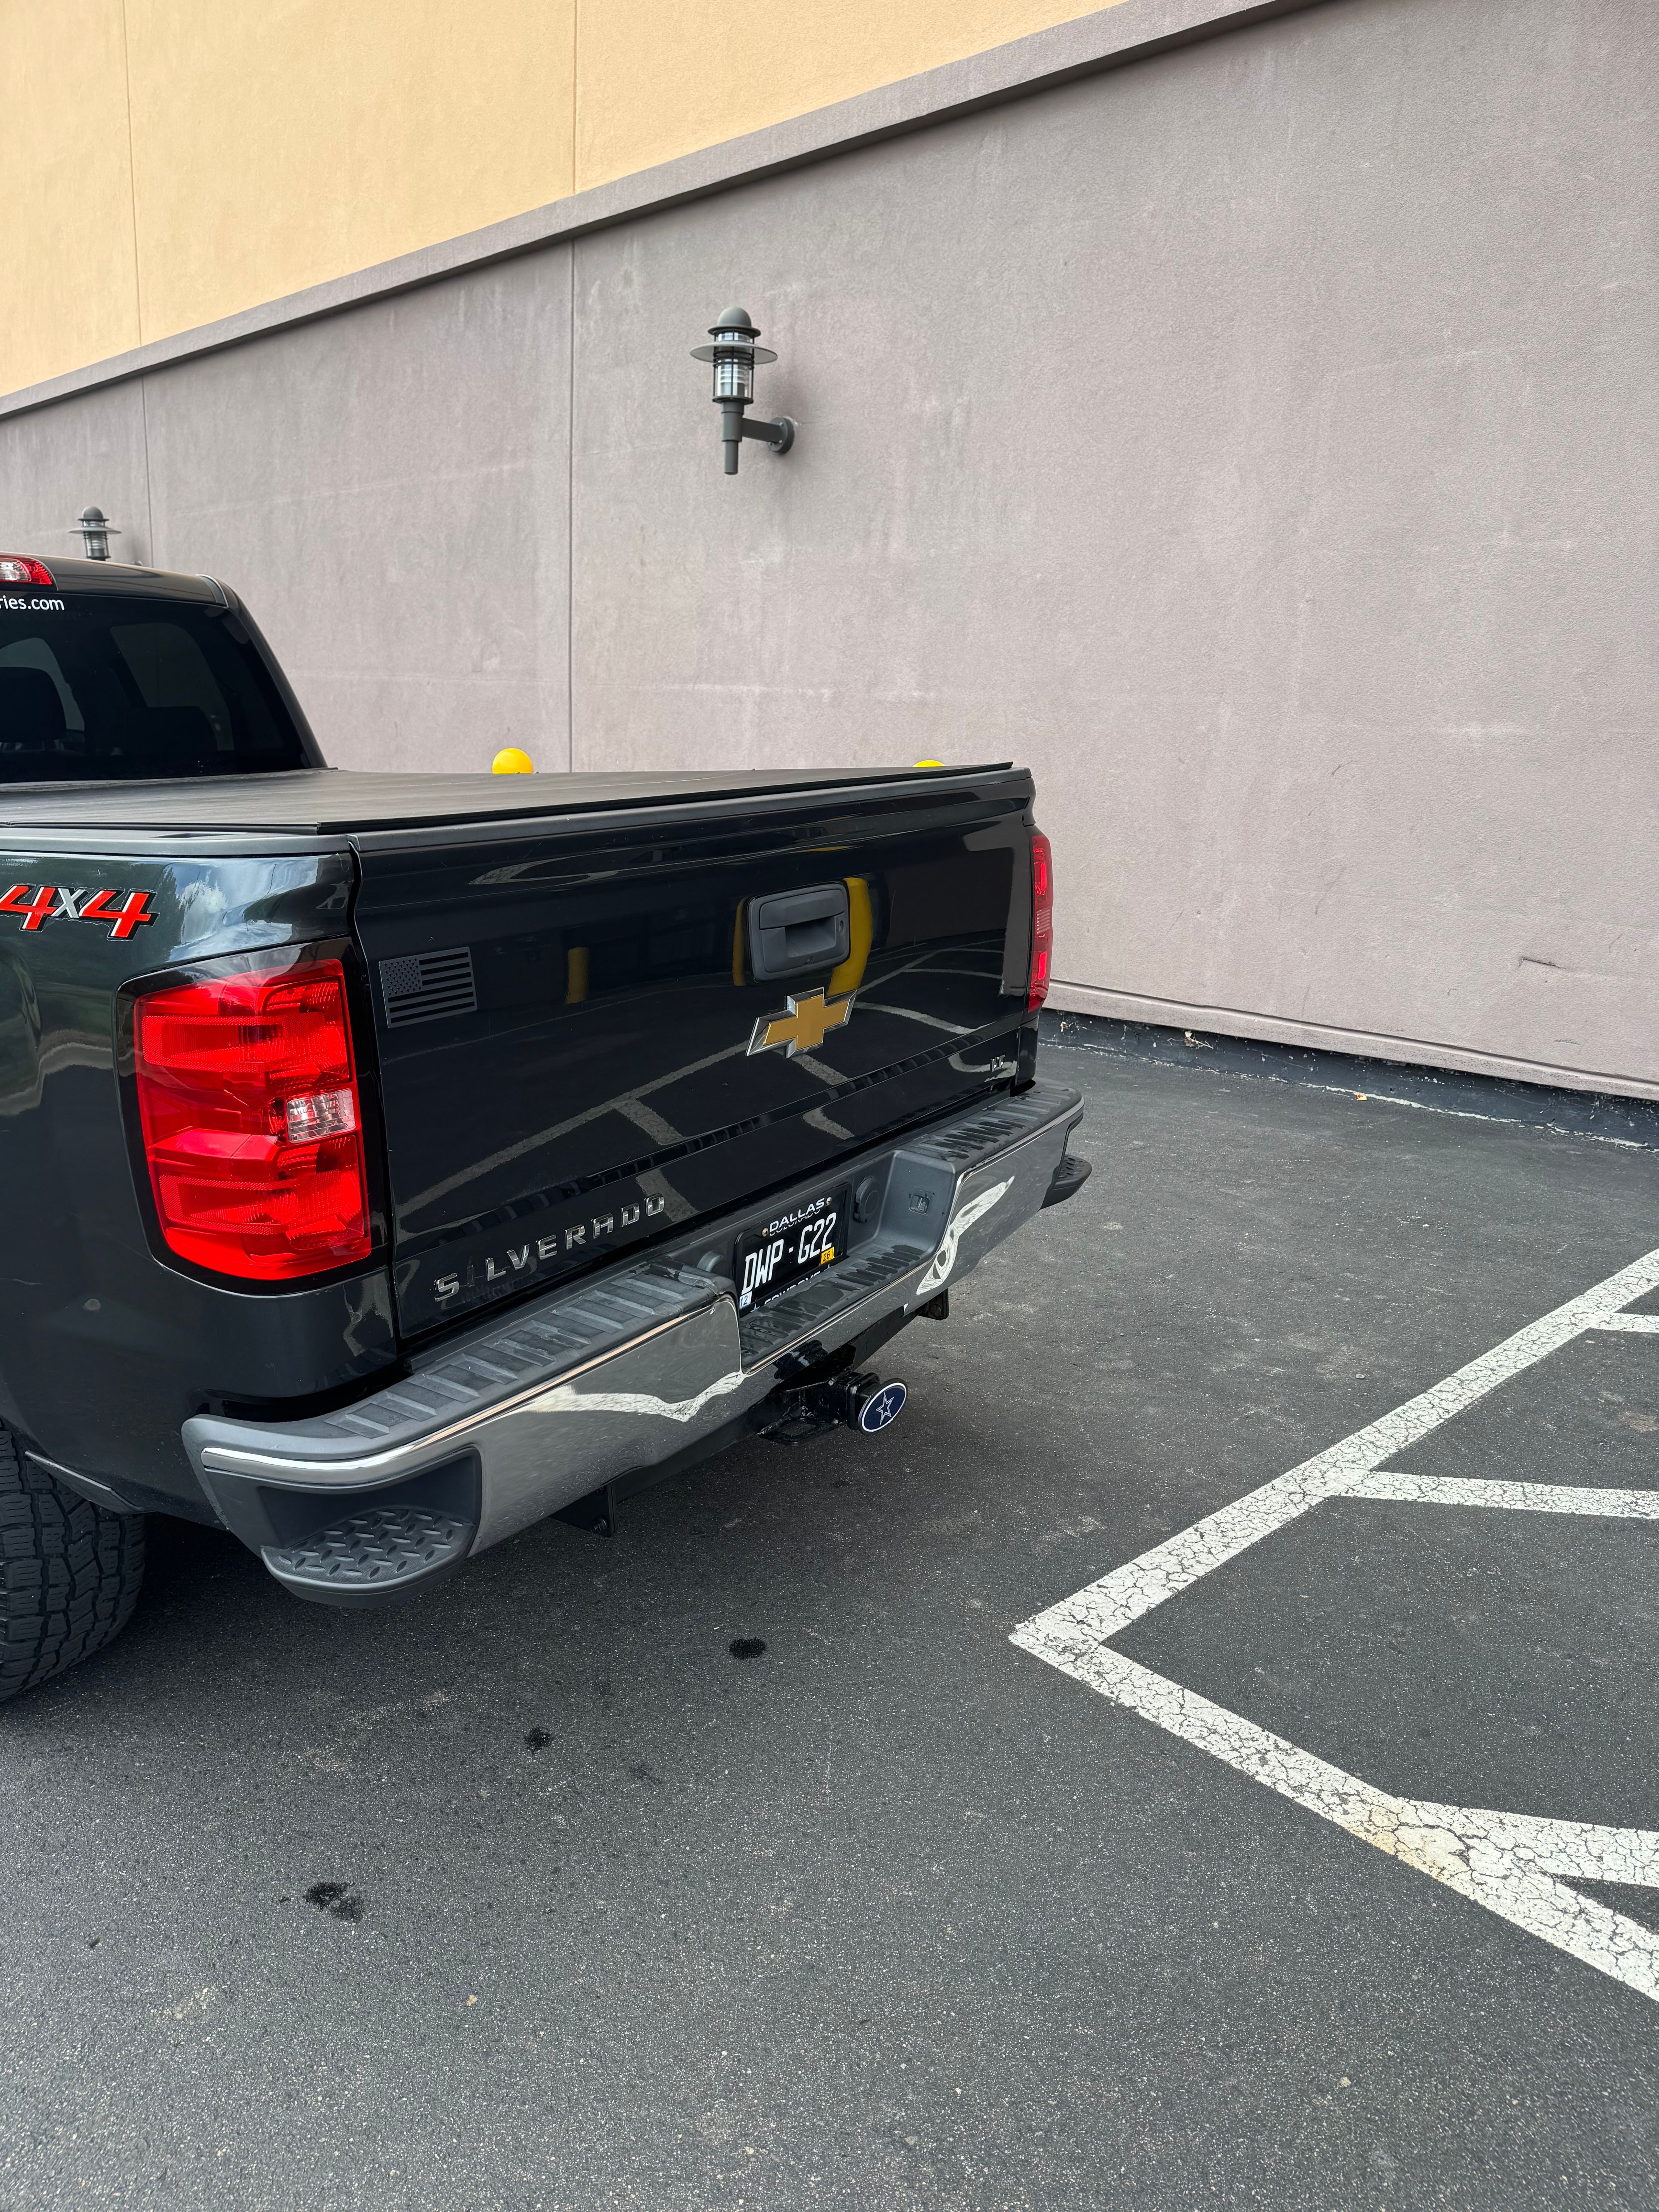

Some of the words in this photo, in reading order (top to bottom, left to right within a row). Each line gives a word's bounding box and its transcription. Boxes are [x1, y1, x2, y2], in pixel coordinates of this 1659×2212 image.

[991, 1054, 1005, 1072] LT
[769, 1197, 825, 1233] DALLAS
[434, 1193, 665, 1302] SLVERADO
[823, 1251, 830, 1262] 26
[740, 1295, 748, 1307] 12
